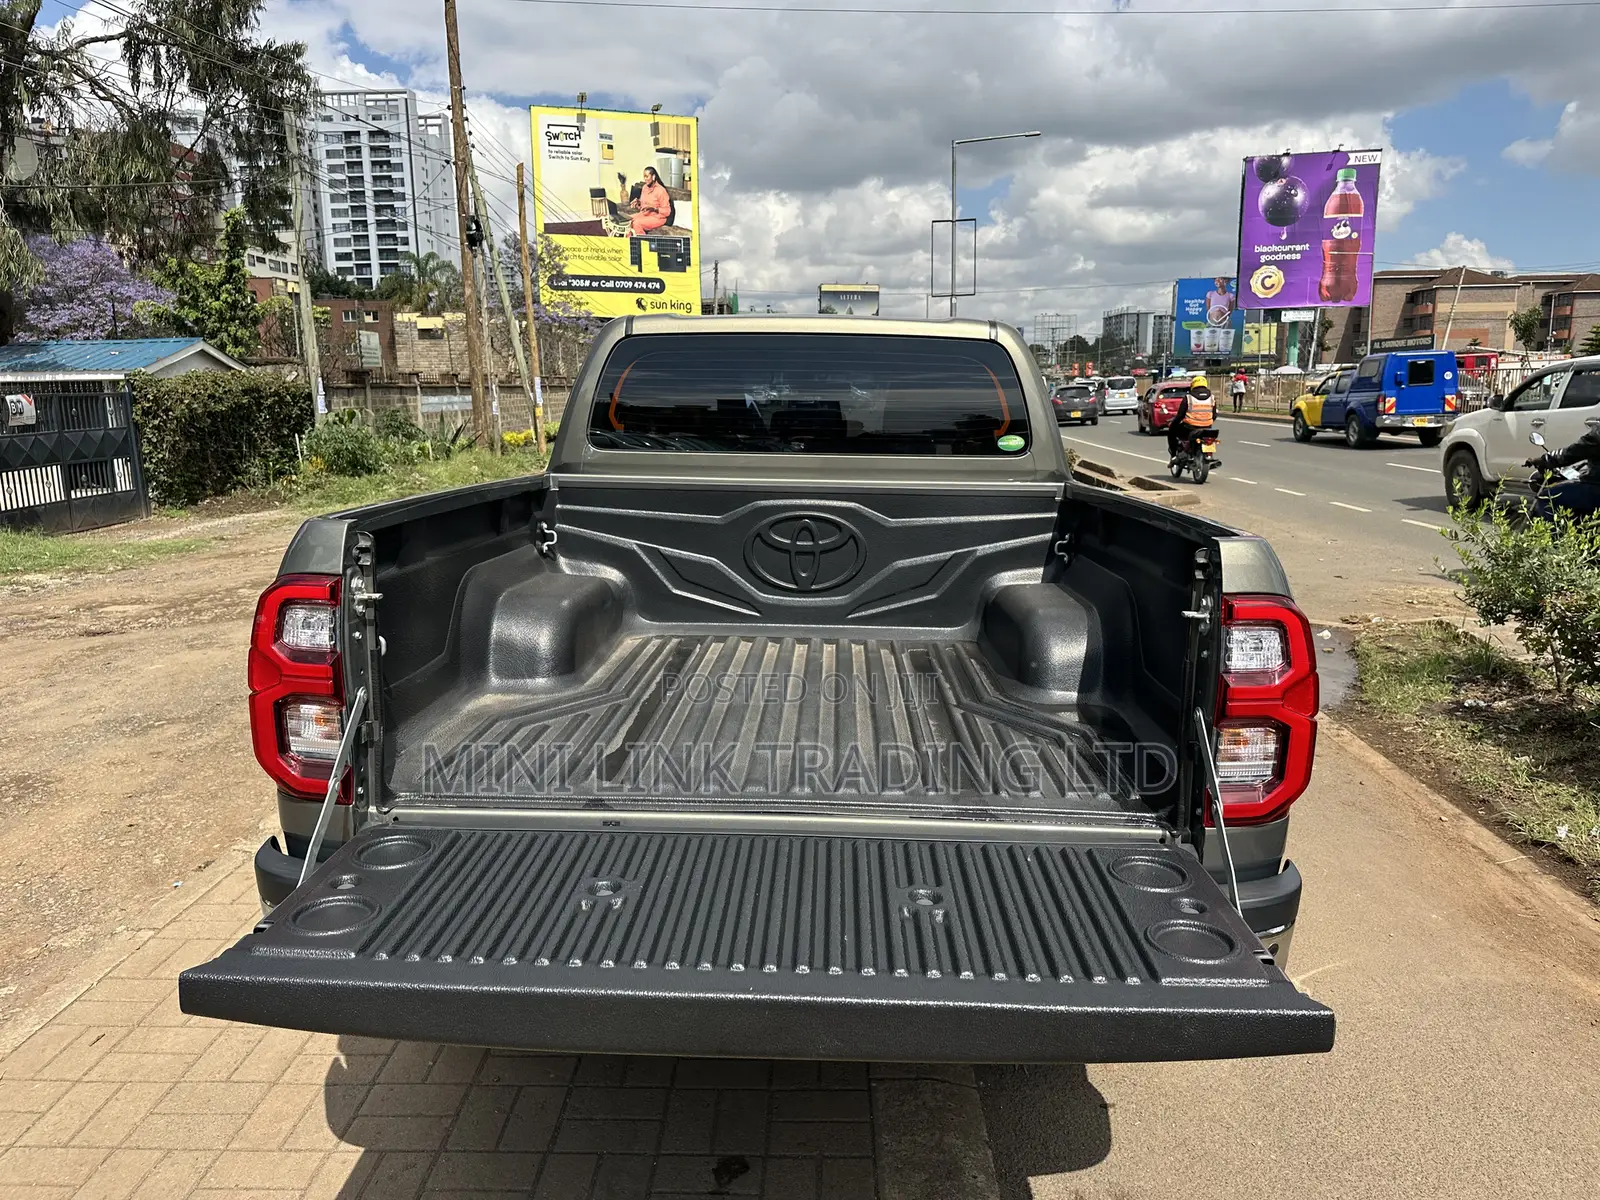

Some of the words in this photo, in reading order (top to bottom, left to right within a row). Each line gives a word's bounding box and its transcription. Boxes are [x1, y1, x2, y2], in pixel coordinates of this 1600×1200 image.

[1354, 154, 1378, 163] NEW
[1254, 243, 1310, 253] blackcurrant
[578, 253, 584, 261] to
[585, 254, 606, 262] reliable
[1260, 252, 1302, 263] goodness
[600, 280, 614, 288] Call
[634, 281, 647, 289] 474
[647, 281, 661, 289] 474
[1260, 274, 1276, 290] C
[650, 301, 668, 309] sun
[670, 299, 692, 313] king
[1407, 337, 1432, 347] MOTORS
